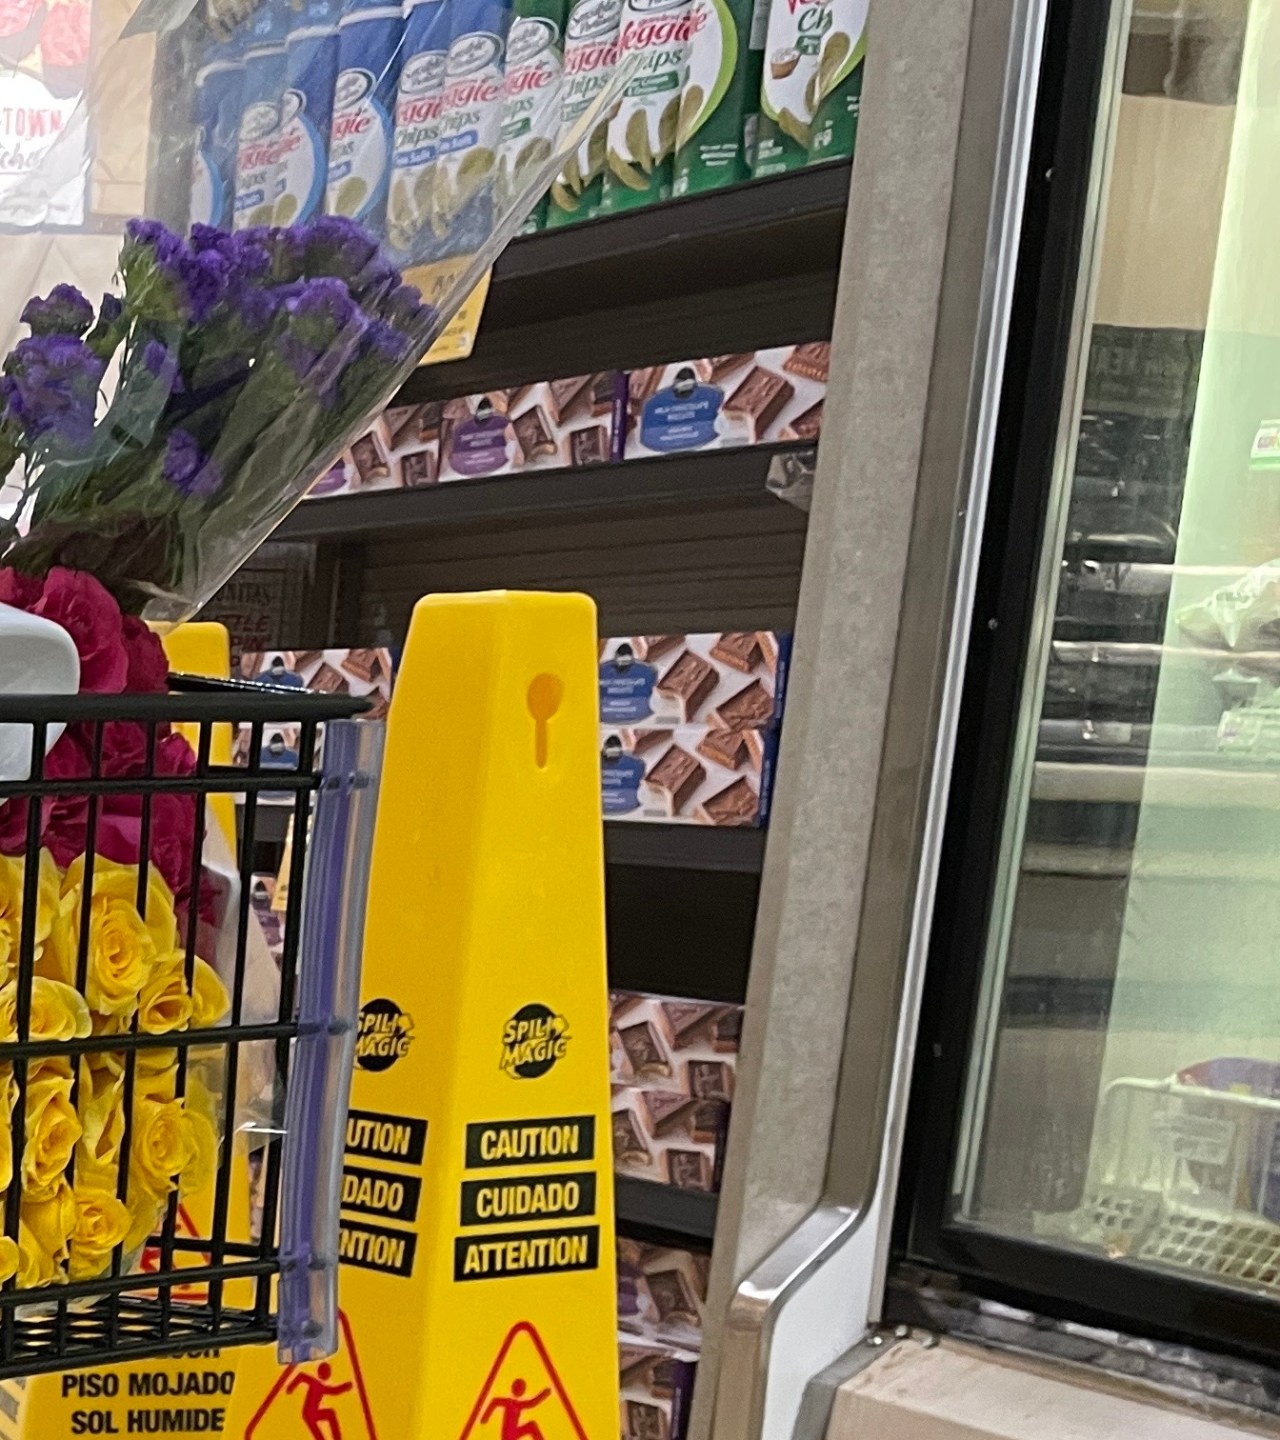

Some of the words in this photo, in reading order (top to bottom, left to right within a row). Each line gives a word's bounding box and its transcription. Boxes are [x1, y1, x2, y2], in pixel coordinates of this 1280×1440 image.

[501, 1040, 568, 1068] MAGIC
[346, 1120, 411, 1157] UTION
[481, 1124, 579, 1161] CAUTION
[343, 1176, 404, 1213] DADO
[476, 1183, 579, 1219] CUIDADO
[339, 1230, 406, 1269] NTION
[464, 1235, 588, 1275] ATTENTION
[61, 1374, 120, 1398] PISO
[127, 1373, 234, 1398] MOJADO
[70, 1408, 119, 1434] SOL
[127, 1407, 225, 1434] HUMIDE
